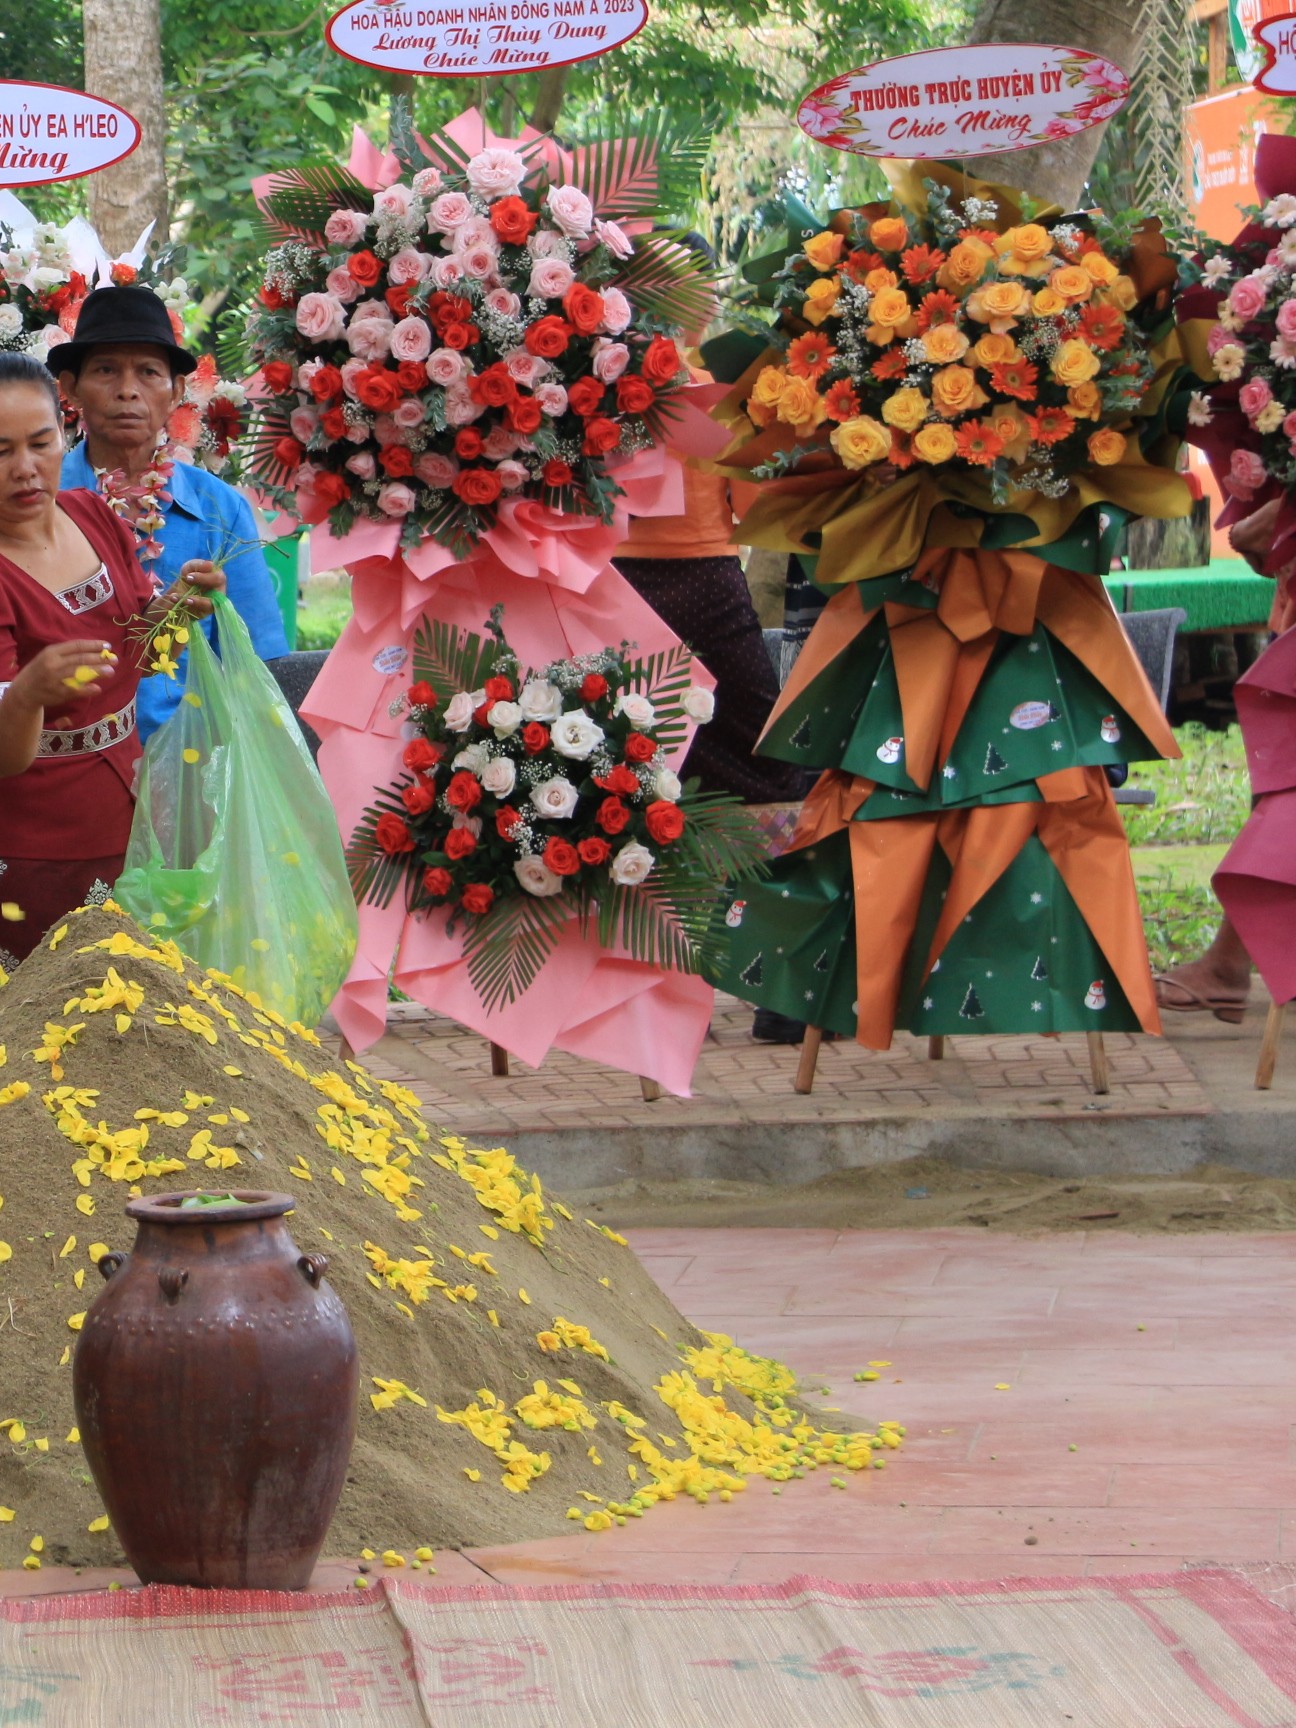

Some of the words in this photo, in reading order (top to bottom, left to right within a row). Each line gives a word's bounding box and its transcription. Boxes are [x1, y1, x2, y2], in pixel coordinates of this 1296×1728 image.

[351, 14, 380, 31] HOA
[383, 8, 413, 32] HẬU
[417, 8, 464, 27] DOANH
[468, 2, 507, 23] NHÂN
[554, 0, 585, 17] NAM
[604, 0, 635, 14] 2023
[372, 32, 437, 52] Lương
[444, 27, 481, 49] Thị
[487, 24, 542, 46] Thùy
[548, 20, 608, 41] Dung
[423, 48, 480, 69] Chúc
[482, 47, 551, 65] Mừng
[850, 81, 920, 113] THƯỜNG
[924, 75, 971, 109] TRỰC
[977, 69, 1035, 102] HUYỆN
[1039, 62, 1064, 94] ỦY
[19, 103, 42, 138] ỦY
[47, 113, 68, 138] EA
[887, 114, 948, 141] Chúc
[954, 109, 1032, 141] Mừng
